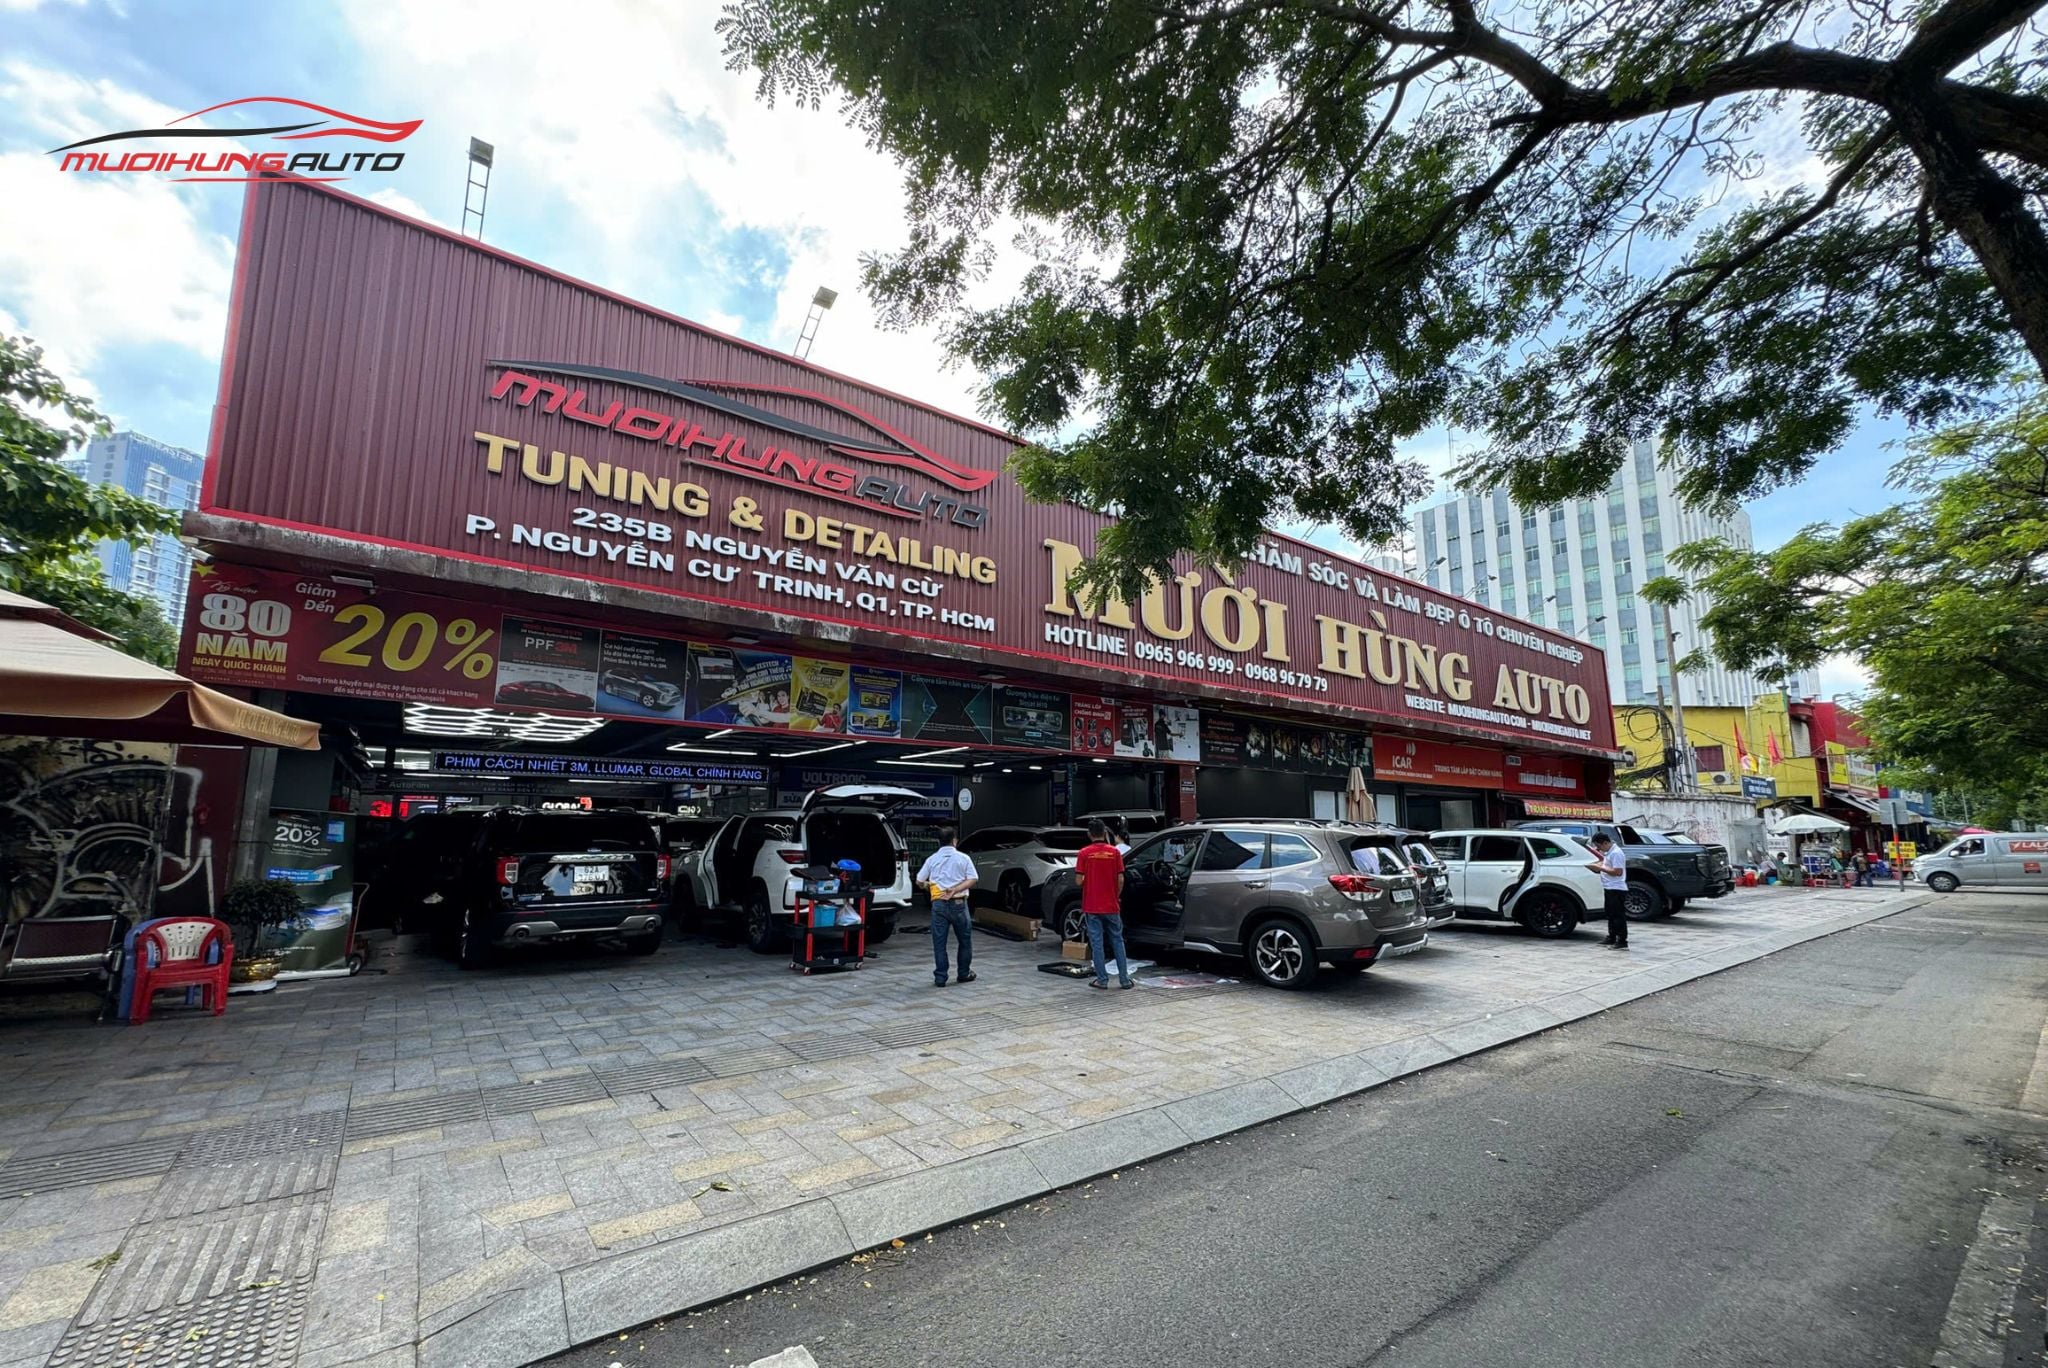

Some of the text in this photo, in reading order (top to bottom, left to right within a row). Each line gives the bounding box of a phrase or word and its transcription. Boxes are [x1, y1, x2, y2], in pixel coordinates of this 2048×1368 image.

[474, 431, 997, 584] TUNING & DETAILING
[466, 514, 500, 539] P.
[511, 524, 674, 573] NGUYỄN
[688, 559, 741, 583] CƯ
[573, 507, 943, 598] 235B NGUYỄN VĂN CỪ
[199, 592, 293, 638] 80
[295, 582, 336, 599] Giảm
[304, 599, 335, 614] Đến
[1308, 561, 1349, 590] SÓC
[1353, 574, 1379, 601] VÀ
[1382, 585, 1421, 614] LÀM
[1424, 601, 1455, 626] ĐẸP
[1459, 608, 1471, 630] Ô
[1473, 617, 1494, 637] TÔ
[1496, 625, 1545, 653] CHUYÊN
[1546, 642, 1584, 668] NGHIỆP
[195, 632, 289, 664] NĂM
[318, 604, 495, 680] 20%
[1135, 640, 1174, 665] 0965
[1176, 649, 1205, 670] 966
[1208, 655, 1235, 675] 999
[1244, 662, 1278, 684] 0968
[1313, 676, 1328, 692] 79
[1315, 609, 1473, 701] HÙNG
[1492, 664, 1591, 725] AUTO
[445, 756, 480, 768] PHIM
[485, 756, 524, 770] CÁCH
[528, 759, 567, 775] NHIỆT
[570, 761, 592, 774] 3M,
[594, 763, 646, 777] LLUMAR,
[649, 766, 694, 778] GLOBAL
[696, 767, 730, 779] CHÍNH
[1392, 755, 1413, 770] ICAR
[274, 825, 321, 847] 20%
